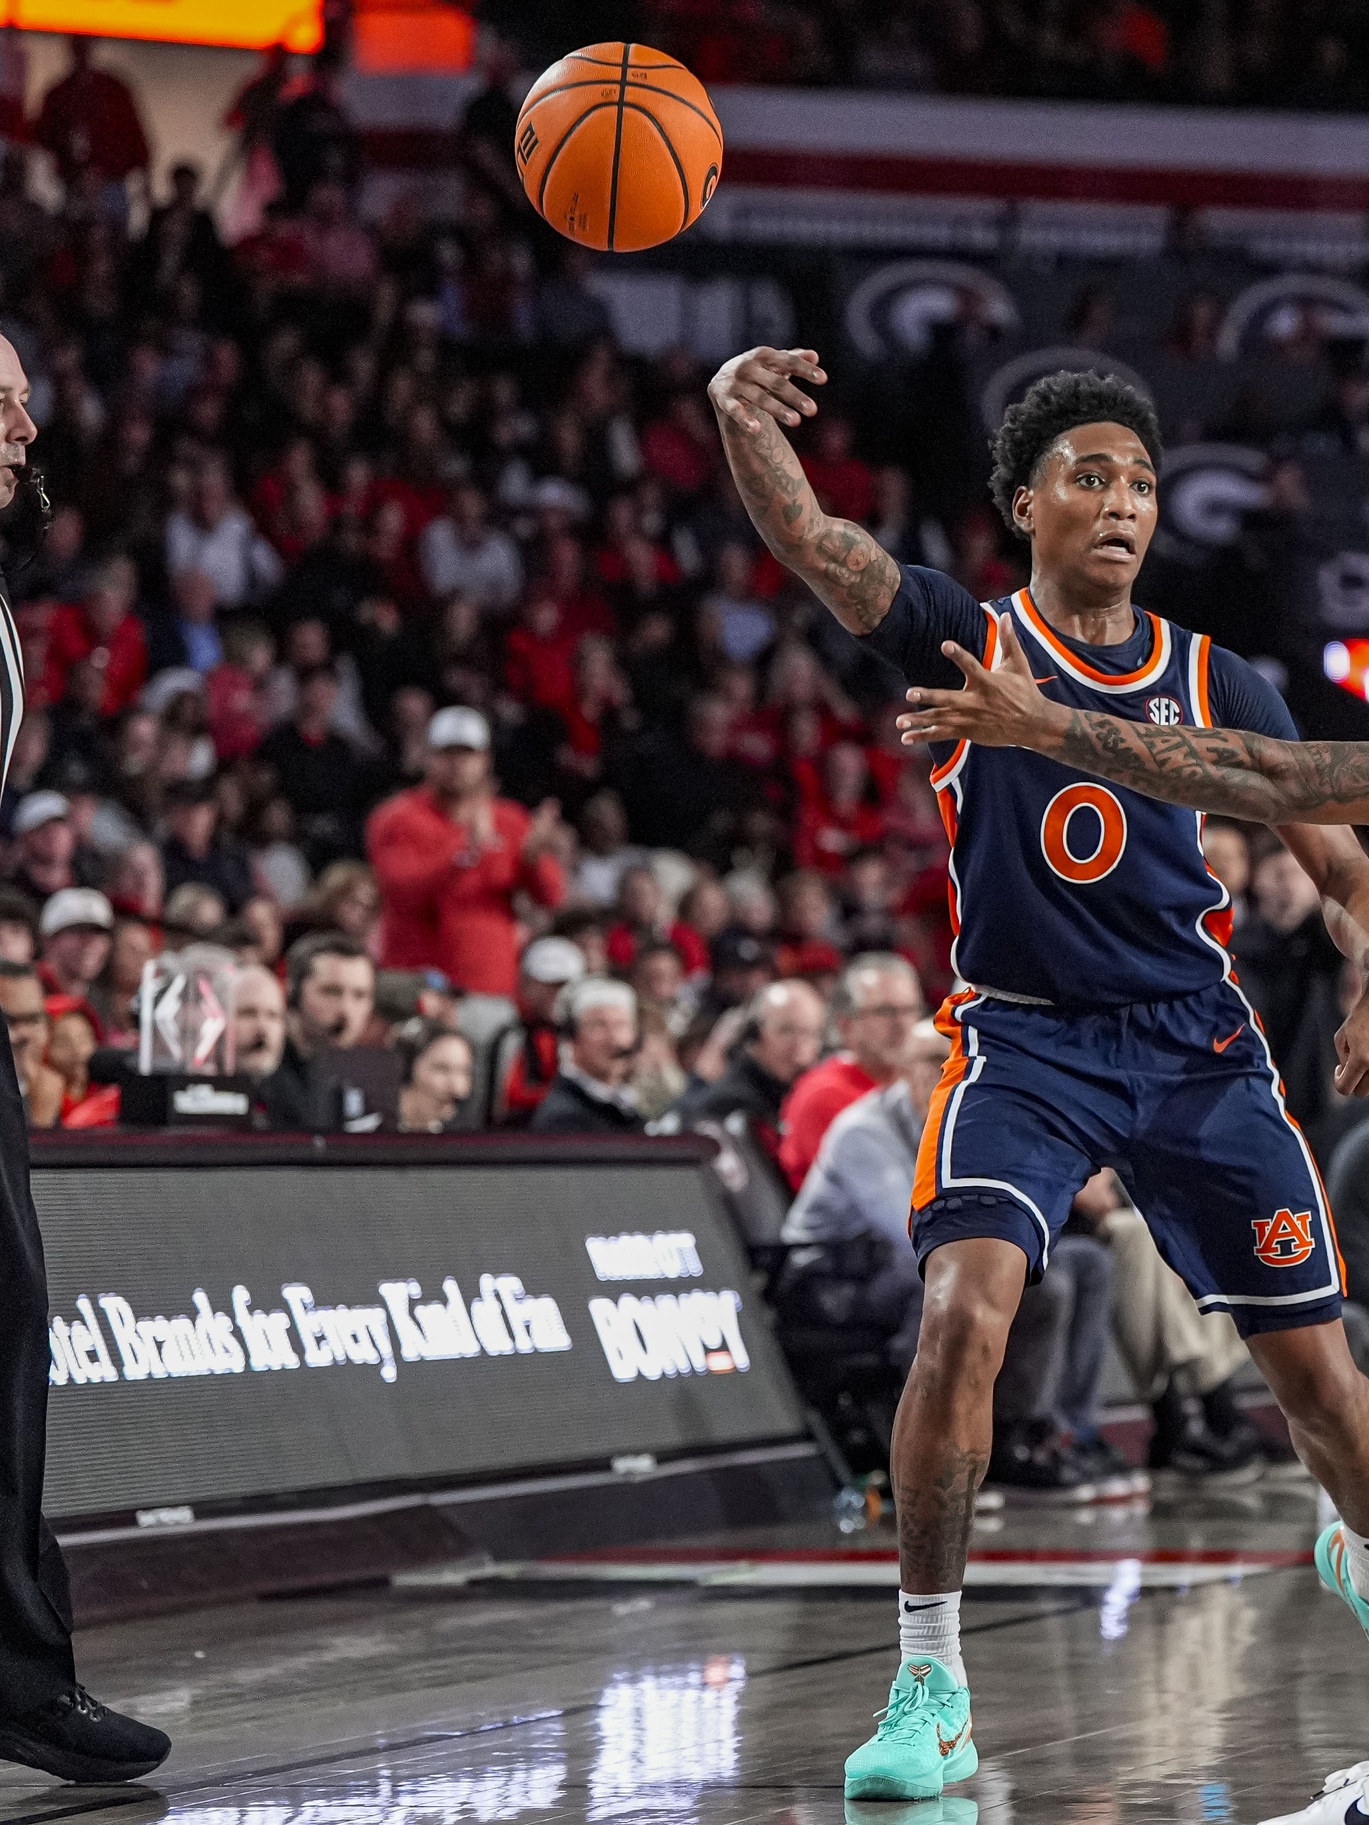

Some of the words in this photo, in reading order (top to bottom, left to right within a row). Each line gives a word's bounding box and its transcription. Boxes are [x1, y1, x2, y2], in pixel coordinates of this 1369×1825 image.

[1148, 697, 1181, 726] SEC
[1040, 782, 1127, 884] 0
[47, 1294, 118, 1386] otel
[98, 1289, 245, 1380] Brands
[231, 1285, 300, 1371] for
[282, 1283, 398, 1382] Every
[378, 1277, 482, 1362] Kind
[470, 1273, 515, 1356] of
[494, 1273, 573, 1354] Fan
